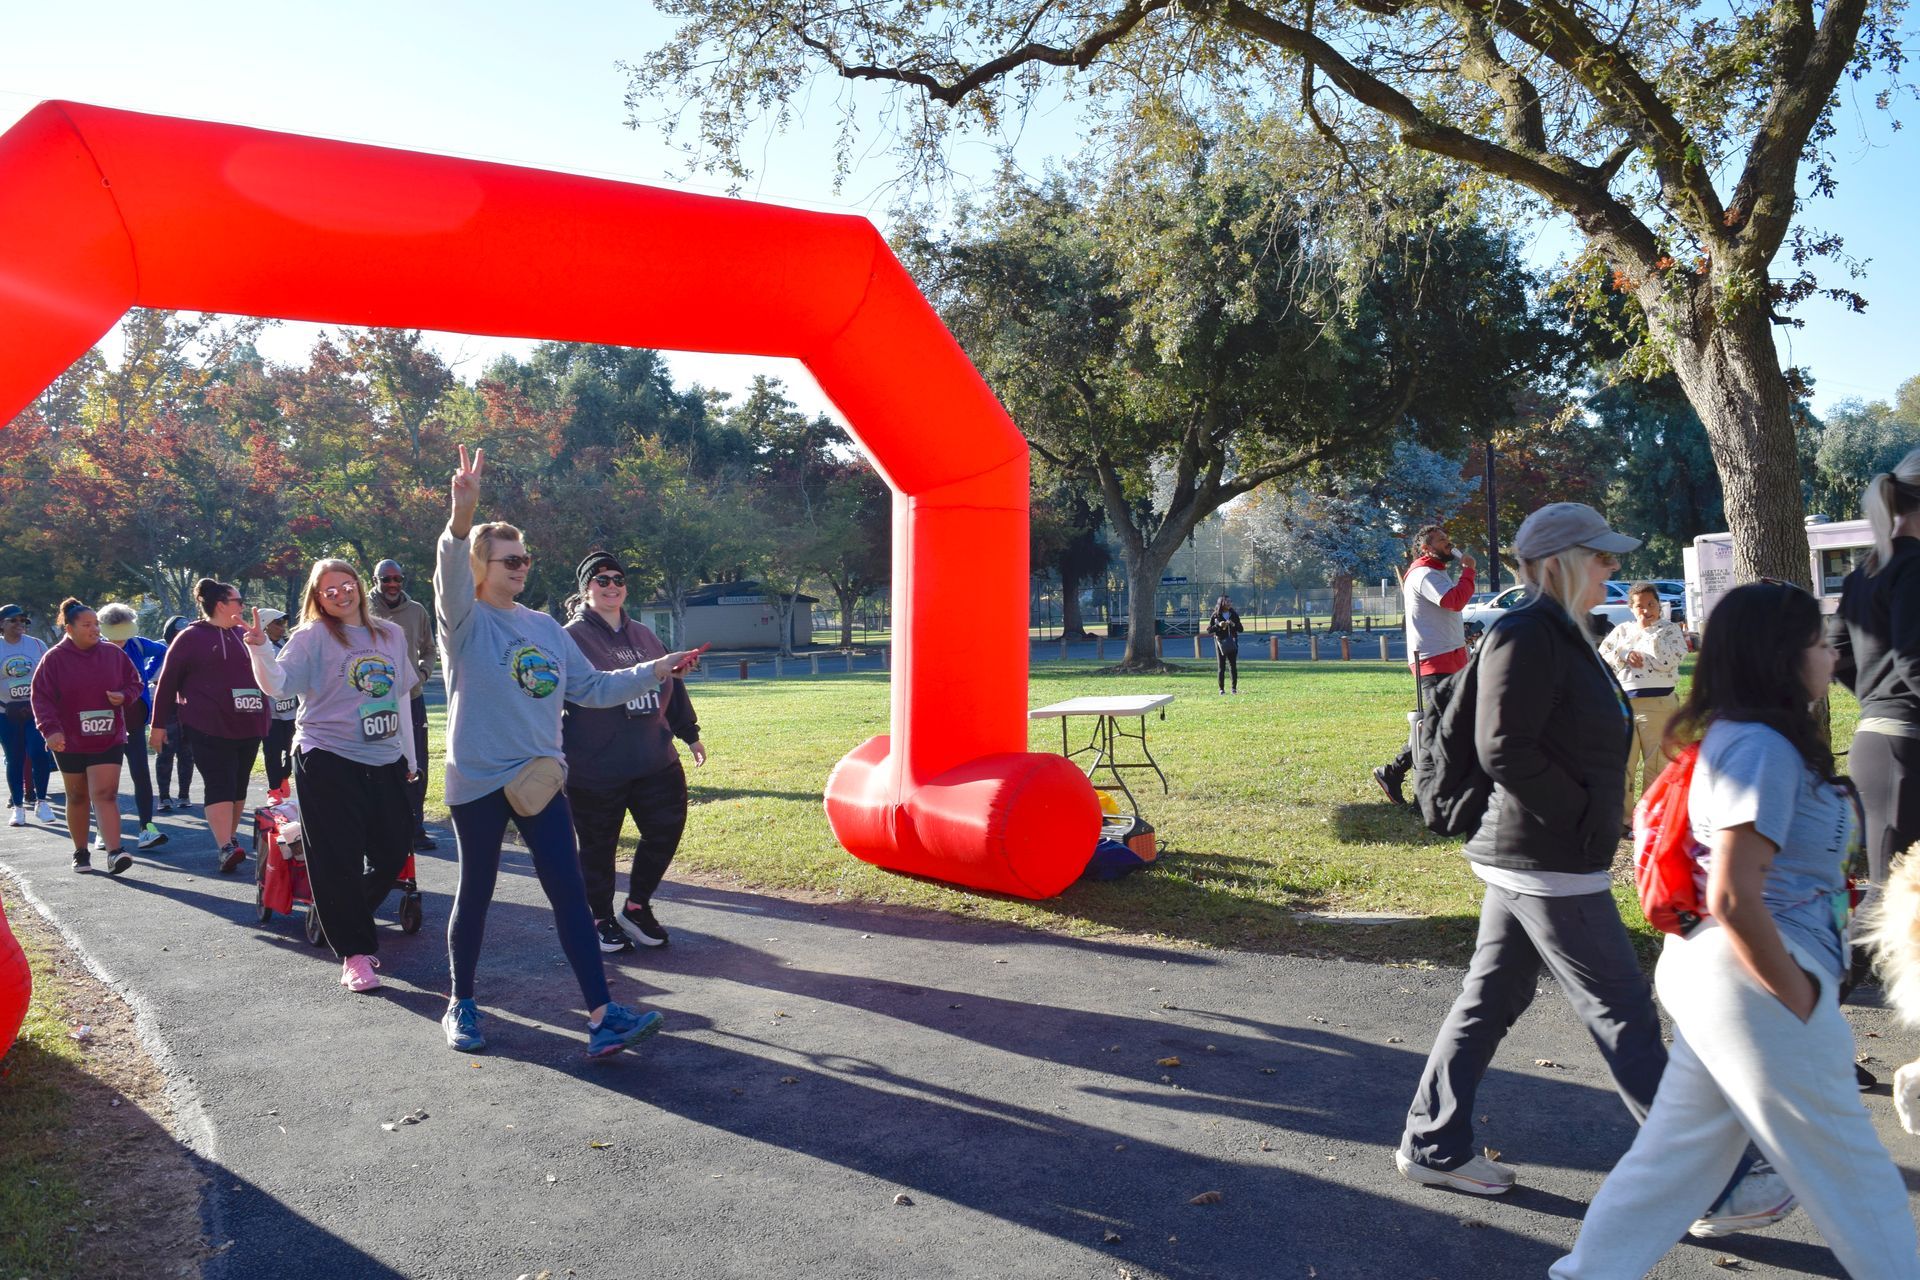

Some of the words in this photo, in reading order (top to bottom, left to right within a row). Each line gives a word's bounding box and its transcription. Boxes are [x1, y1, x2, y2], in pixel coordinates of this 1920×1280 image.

[234, 697, 263, 710] 6025
[81, 718, 114, 733] 6027
[363, 713, 398, 736] 6010
